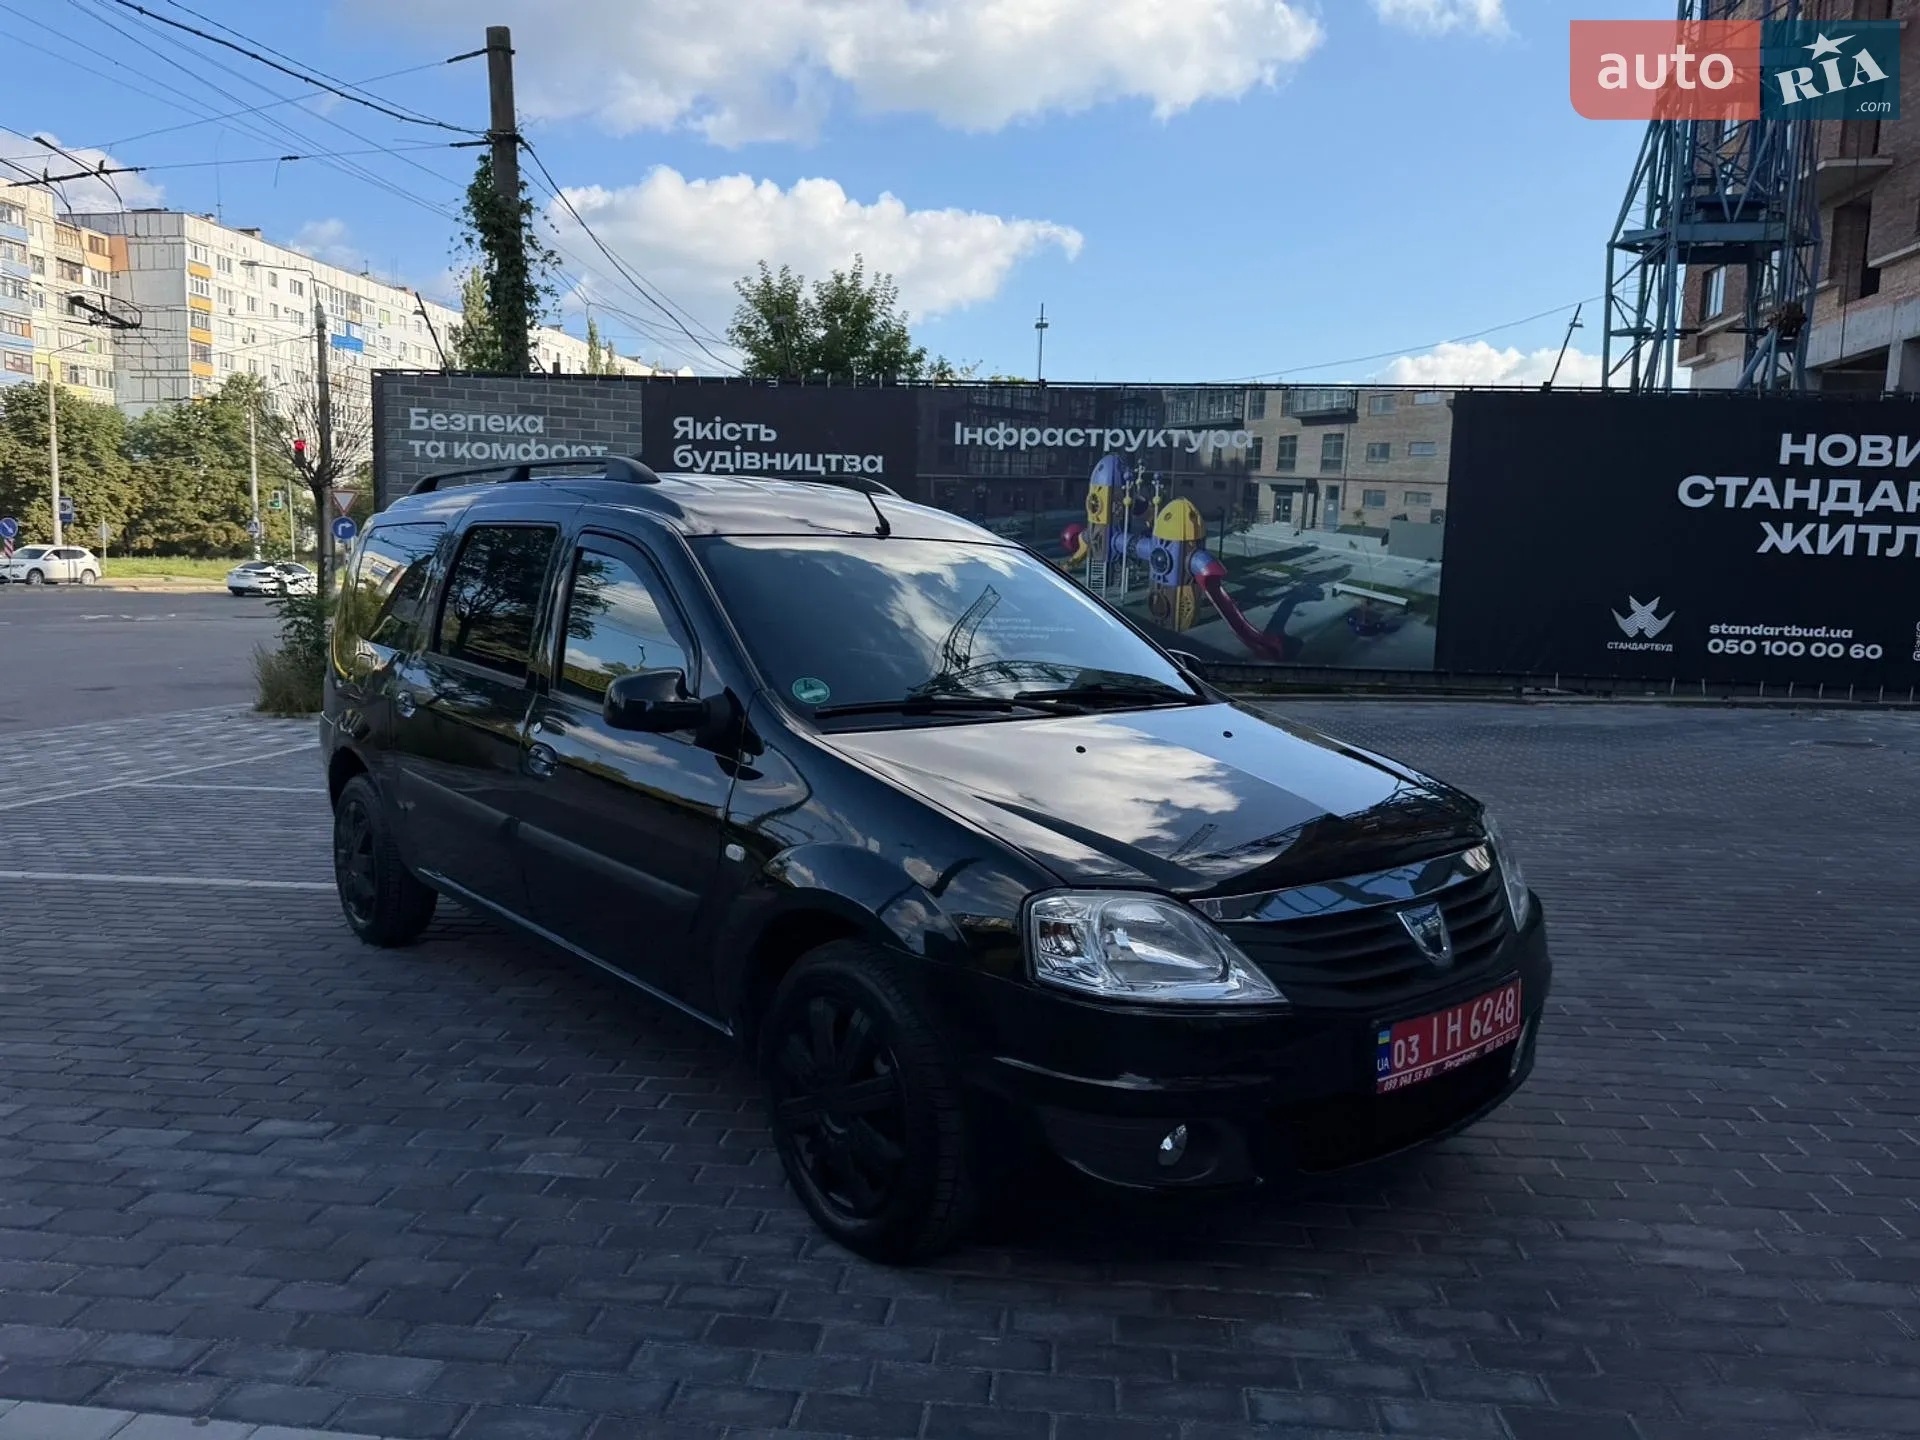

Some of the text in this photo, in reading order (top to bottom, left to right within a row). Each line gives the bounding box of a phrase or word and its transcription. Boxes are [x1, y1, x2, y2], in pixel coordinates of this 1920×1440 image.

[408, 407, 544, 433] Безпека
[673, 416, 777, 441] Якість
[408, 440, 446, 458] та
[954, 422, 1254, 453] Інфраструктура
[673, 444, 883, 475] будівництва
[1756, 521, 1920, 557] ЖИТЛ
[1709, 623, 1853, 639] standartbud.ua
[1606, 641, 1673, 652] СТАНДАРТБУД
[1707, 638, 1883, 659] 050 100 00 60
[1394, 1034, 1420, 1069] 03
[1470, 986, 1515, 1041] 6248
[1377, 1057, 1390, 1071] UA
